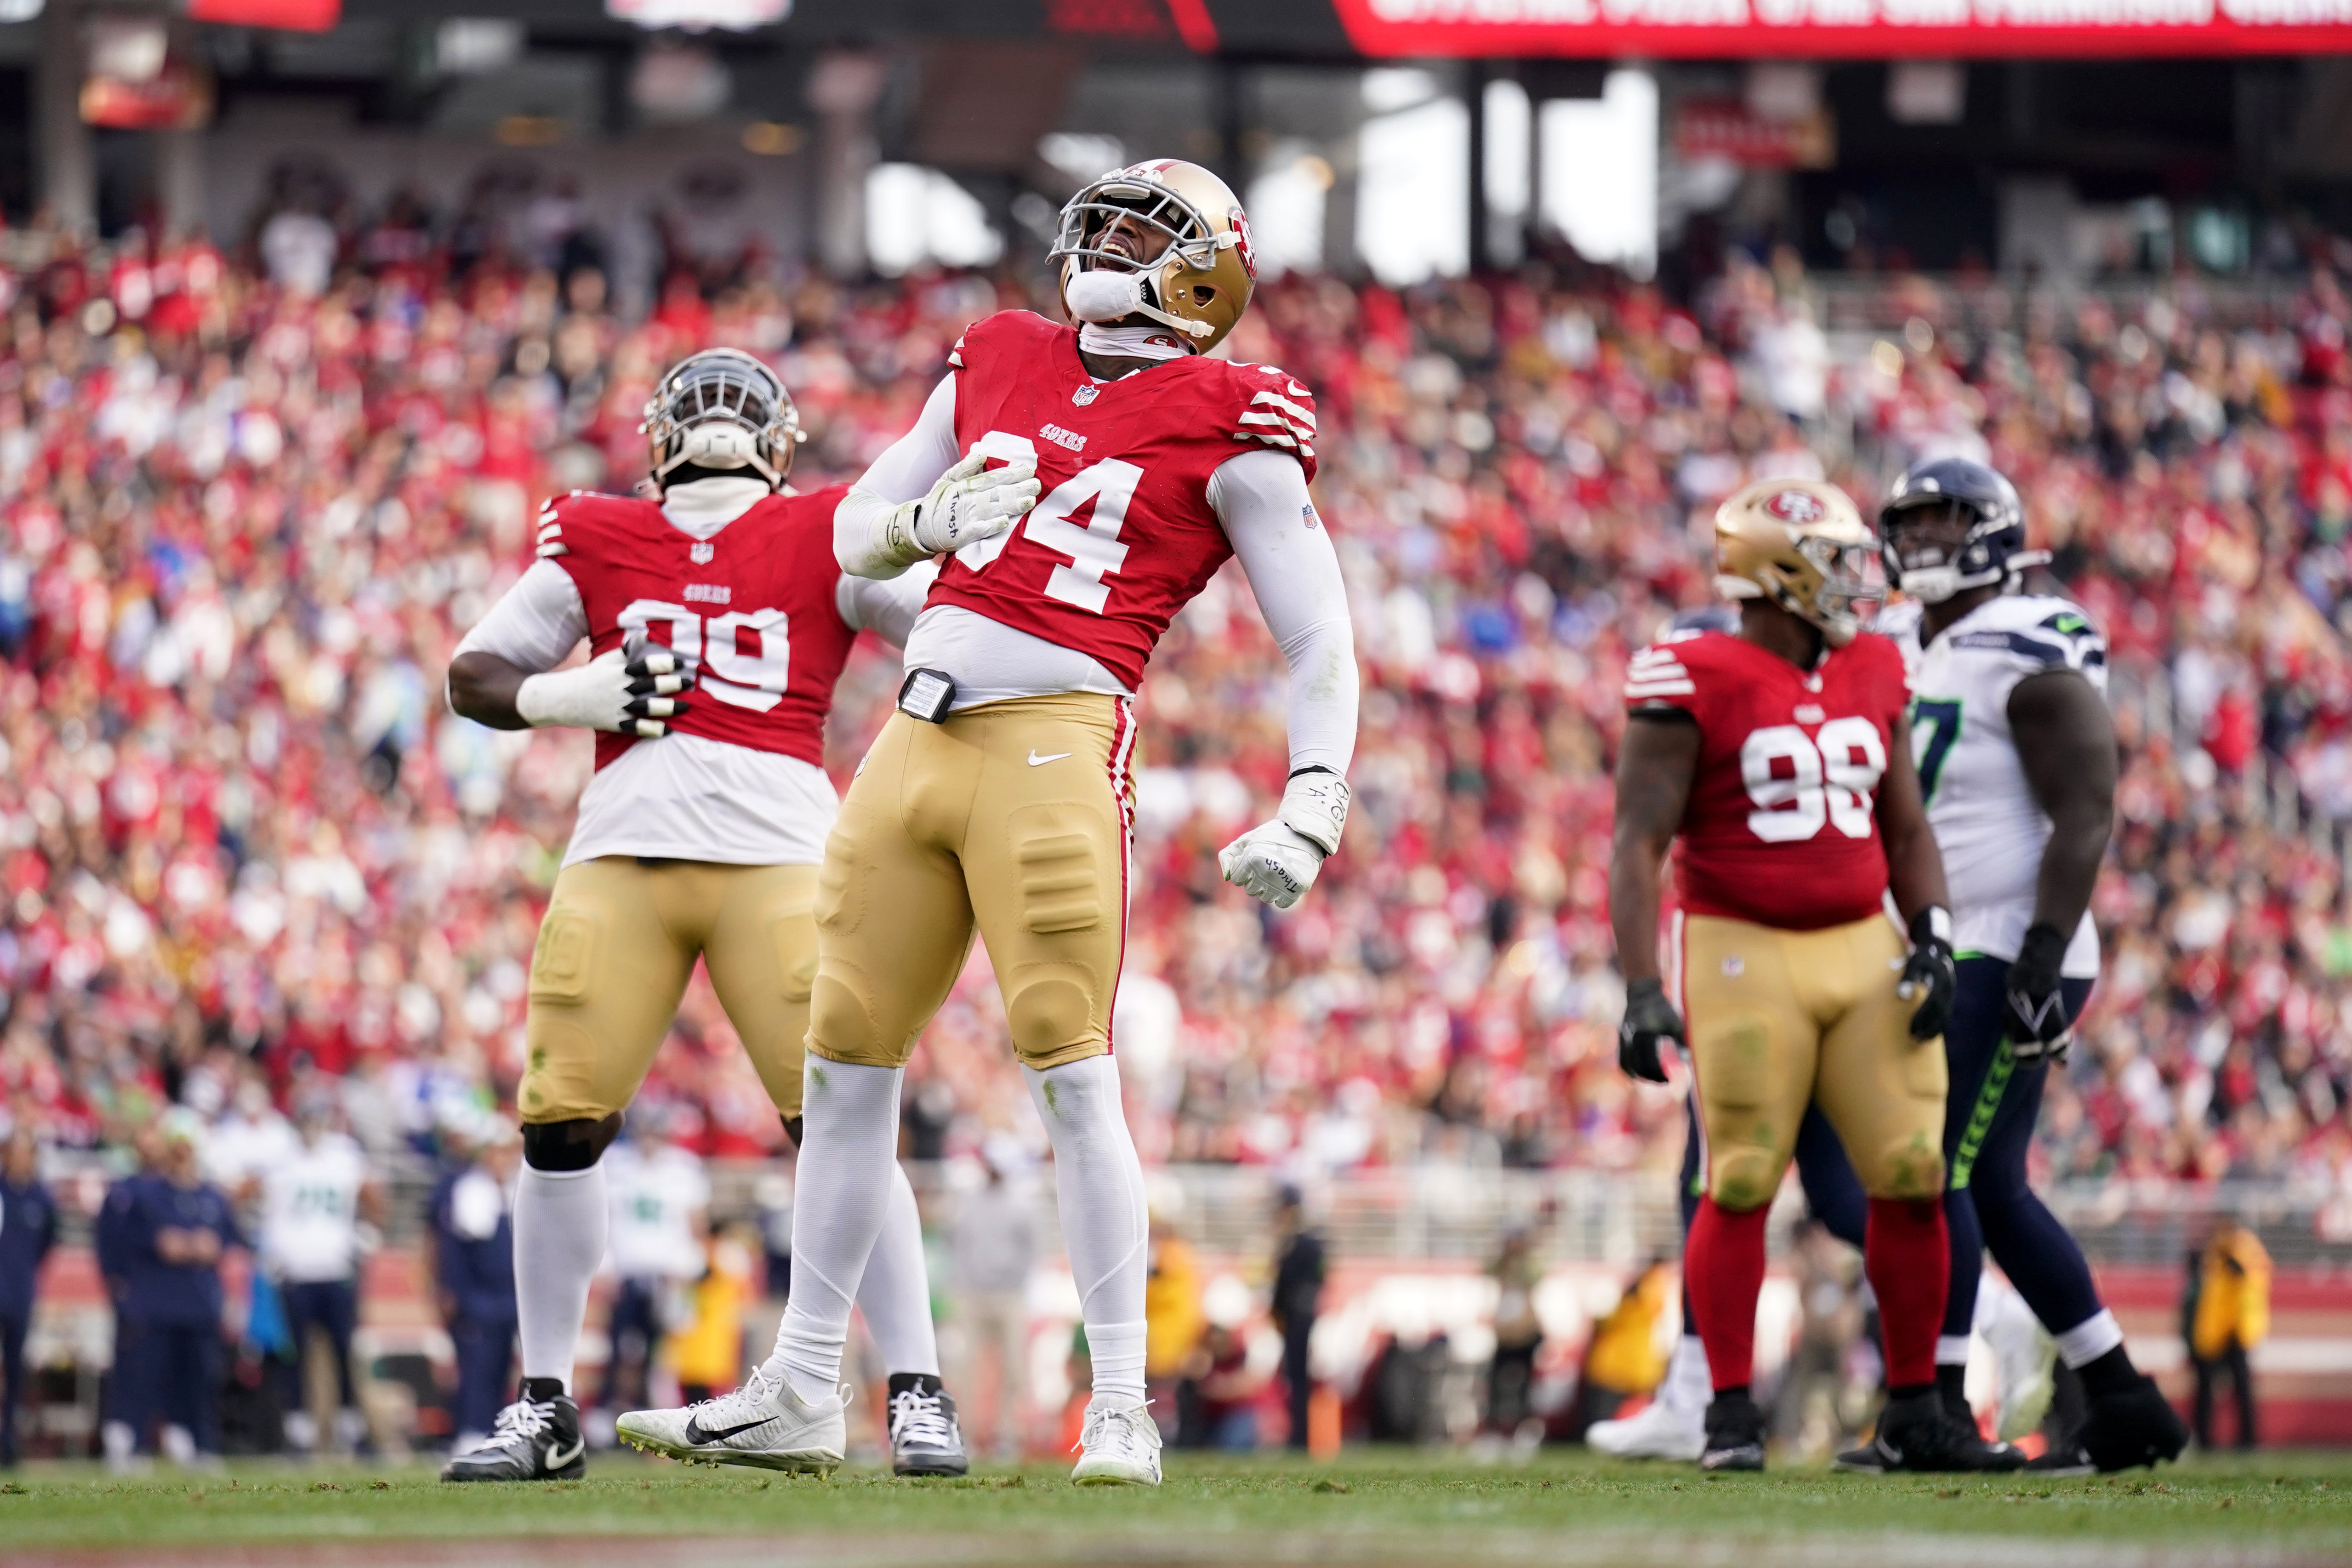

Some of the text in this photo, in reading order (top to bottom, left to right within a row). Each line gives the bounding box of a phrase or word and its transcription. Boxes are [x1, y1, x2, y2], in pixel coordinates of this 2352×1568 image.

[1076, 393, 1090, 403] NFL
[1039, 423, 1088, 452] 49ERS
[950, 490, 959, 538] Thrash
[1304, 513, 1317, 527] NFL
[1740, 715, 1886, 843] 98
[1266, 858, 1298, 894] Thrash
